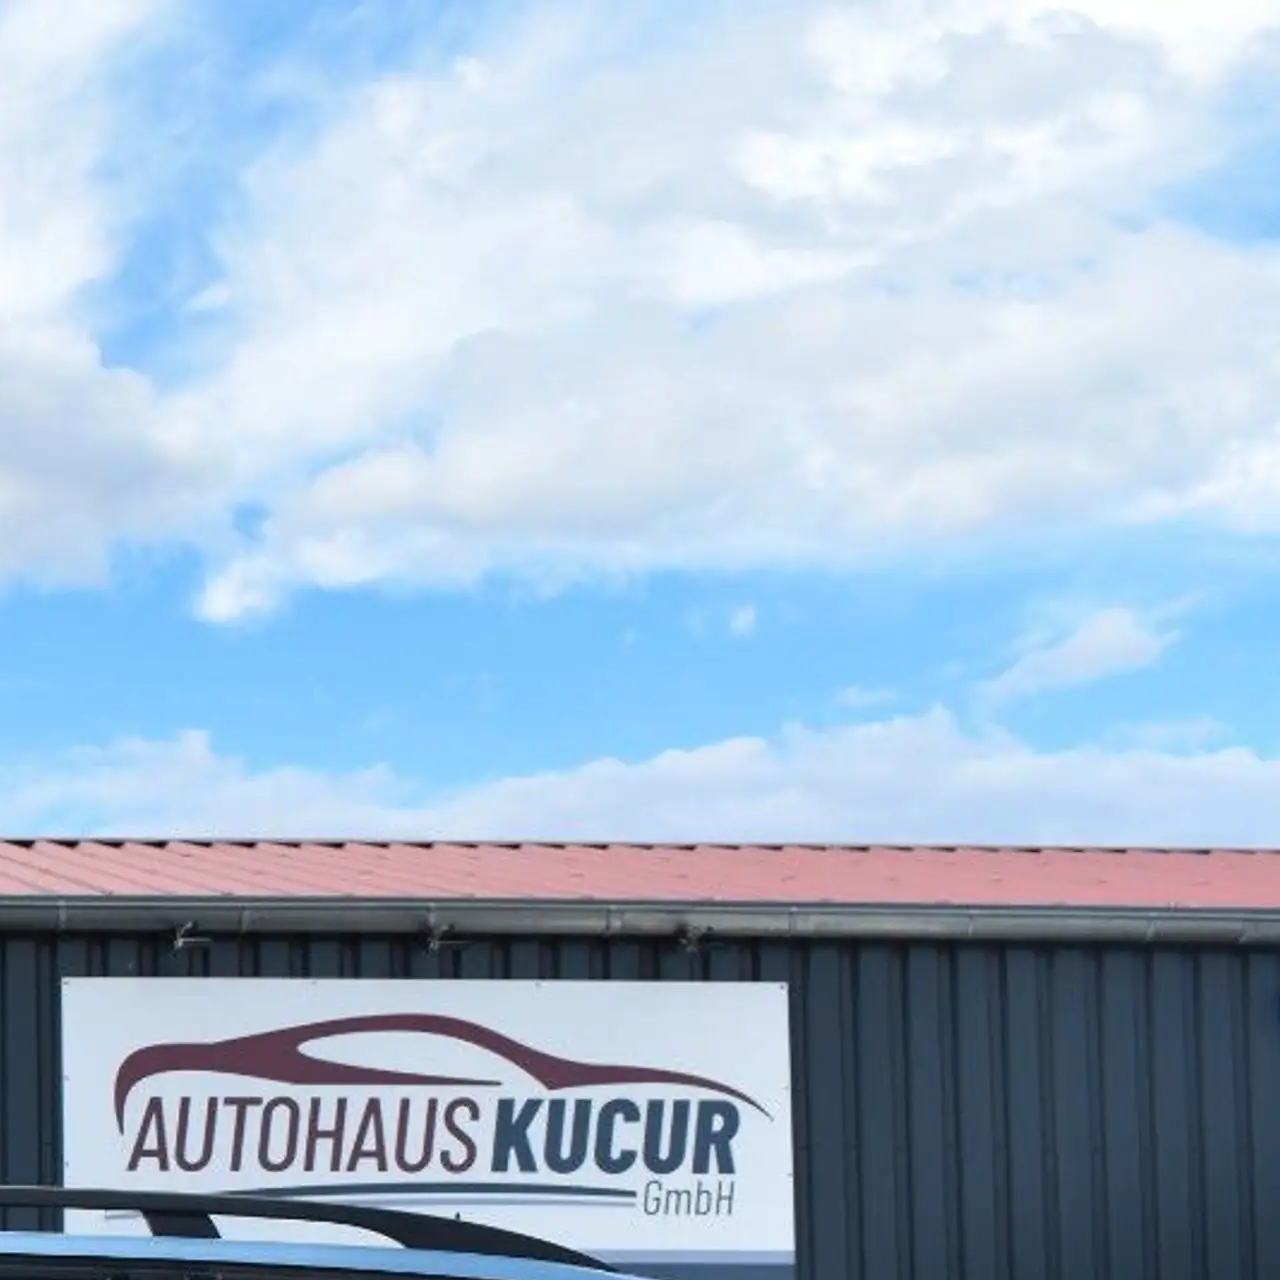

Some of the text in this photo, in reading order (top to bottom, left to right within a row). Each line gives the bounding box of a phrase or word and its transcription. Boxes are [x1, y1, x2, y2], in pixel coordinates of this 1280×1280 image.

[127, 1096, 740, 1175] AUTOHAUS KUCUR
[642, 1179, 735, 1216] GmbH
